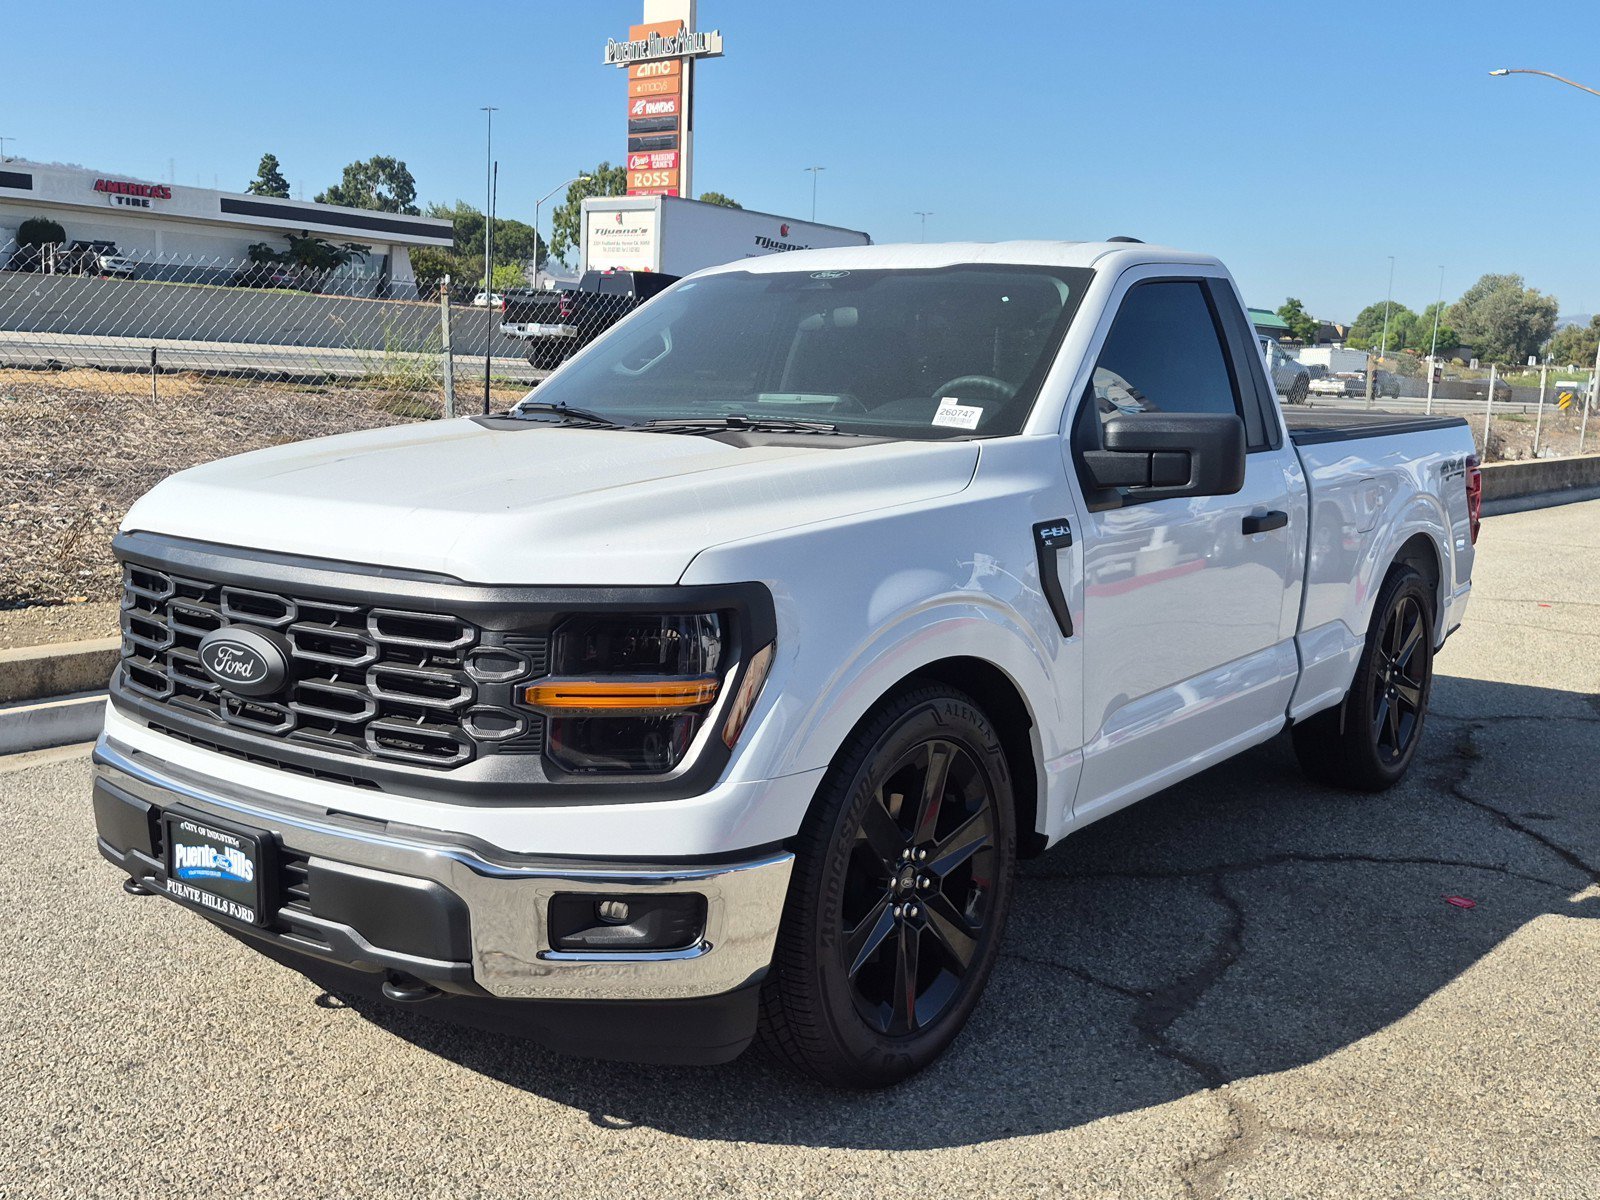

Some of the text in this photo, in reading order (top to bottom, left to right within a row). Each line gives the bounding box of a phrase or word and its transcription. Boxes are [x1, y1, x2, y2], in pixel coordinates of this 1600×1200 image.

[94, 179, 172, 200] AMERICA'S
[634, 172, 669, 187] ROSS
[115, 196, 150, 208] TIRE
[594, 227, 648, 236] Tijuana's
[939, 408, 975, 418] 260747
[214, 646, 254, 678] Ford
[944, 703, 991, 740] ALENZA
[184, 821, 236, 845] CITY OF INDUSTRY
[175, 843, 217, 869] Puente
[225, 845, 254, 881] Hills
[166, 879, 254, 923] PUENTE HILLS FORD
